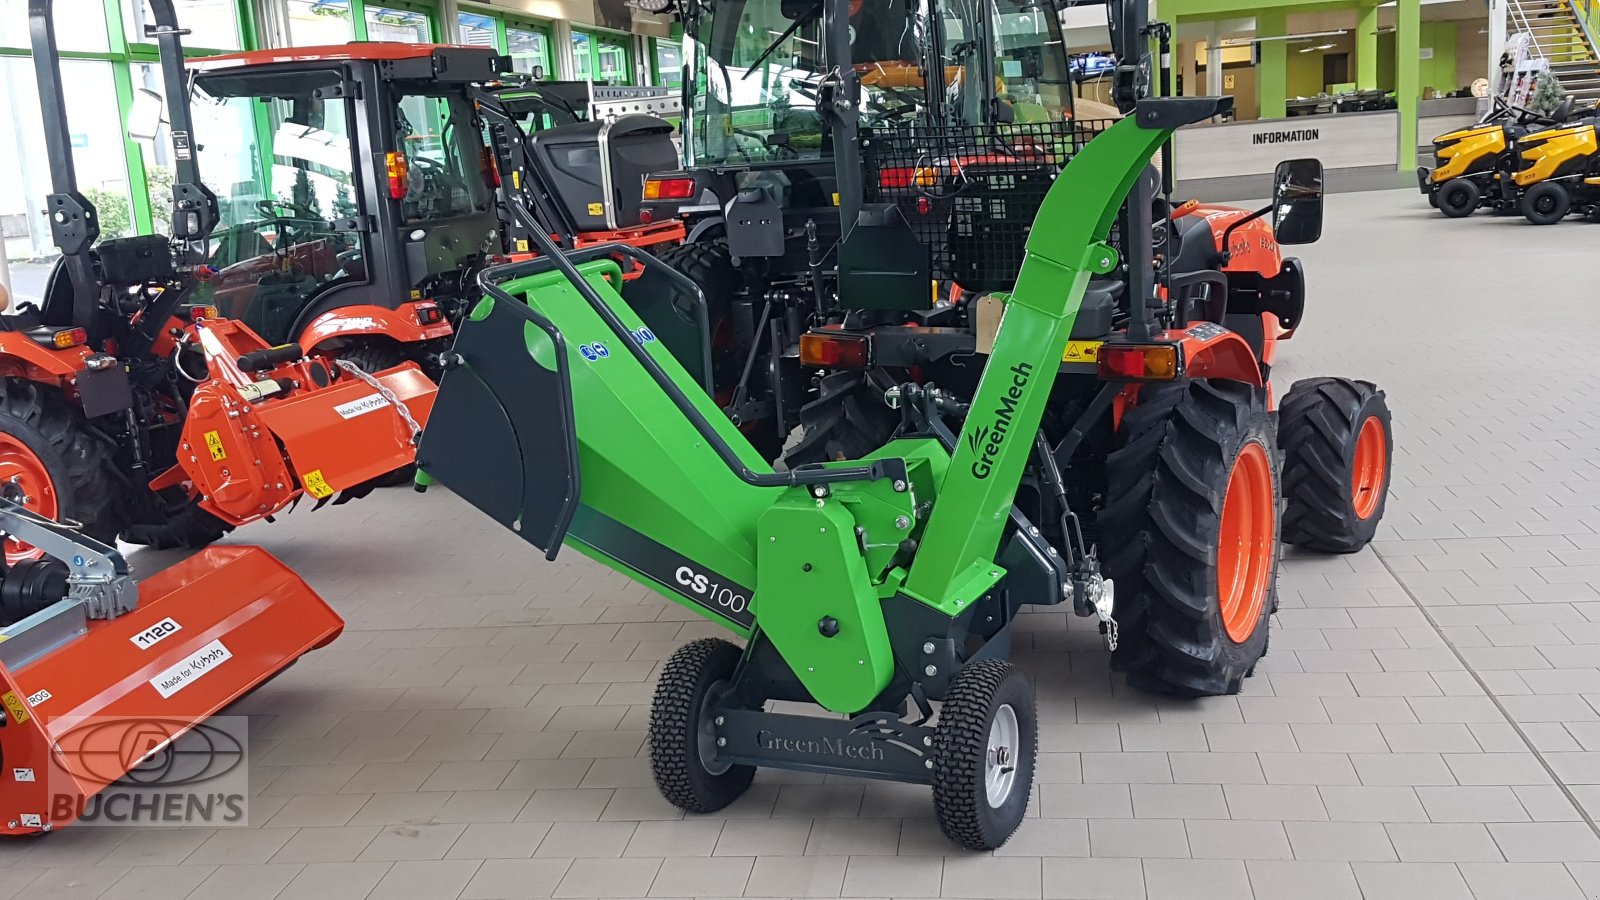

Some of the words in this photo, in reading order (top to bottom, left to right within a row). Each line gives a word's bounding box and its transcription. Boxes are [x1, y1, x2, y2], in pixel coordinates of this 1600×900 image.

[1252, 128, 1319, 145] INFORMATION
[361, 397, 387, 408] Kubota
[971, 362, 1033, 480] GreenMech
[675, 566, 746, 613] CS100
[138, 621, 176, 645] 1120
[161, 675, 183, 690] Made
[181, 668, 192, 678] for
[189, 648, 225, 670] Kubota
[757, 730, 884, 760] GreenMech
